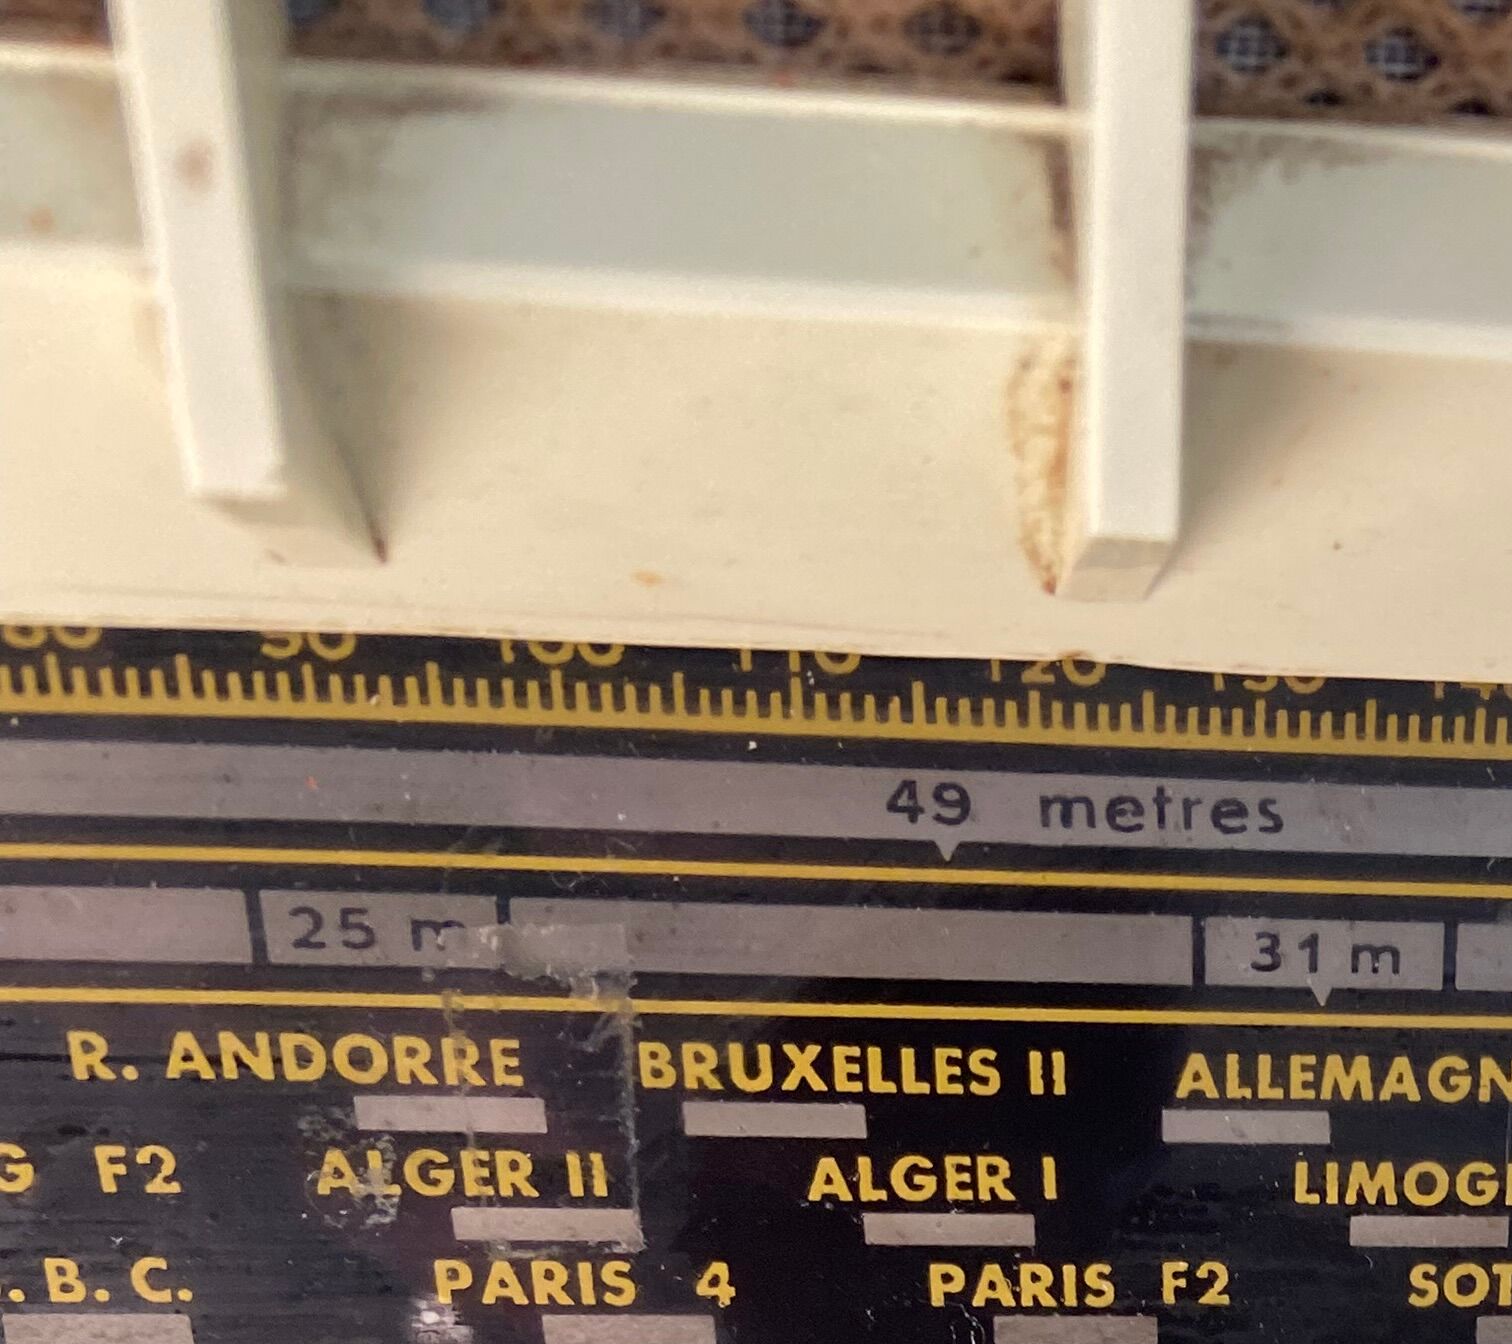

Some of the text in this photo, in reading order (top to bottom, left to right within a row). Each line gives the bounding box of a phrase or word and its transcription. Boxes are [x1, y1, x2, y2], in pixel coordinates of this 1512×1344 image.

[886, 779, 1285, 836] 49 metres
[288, 906, 376, 950] 25
[1250, 931, 1400, 976] 31 m
[66, 1030, 525, 1087] R. ANDORRE
[638, 1041, 1002, 1096] BRUXELLES
[93, 1145, 182, 1195] F2
[316, 1149, 540, 1199] ALGER
[808, 1155, 1016, 1203] ALGER
[433, 1259, 737, 1307] PARIS 4
[928, 1261, 1231, 1308] PARIS F2
